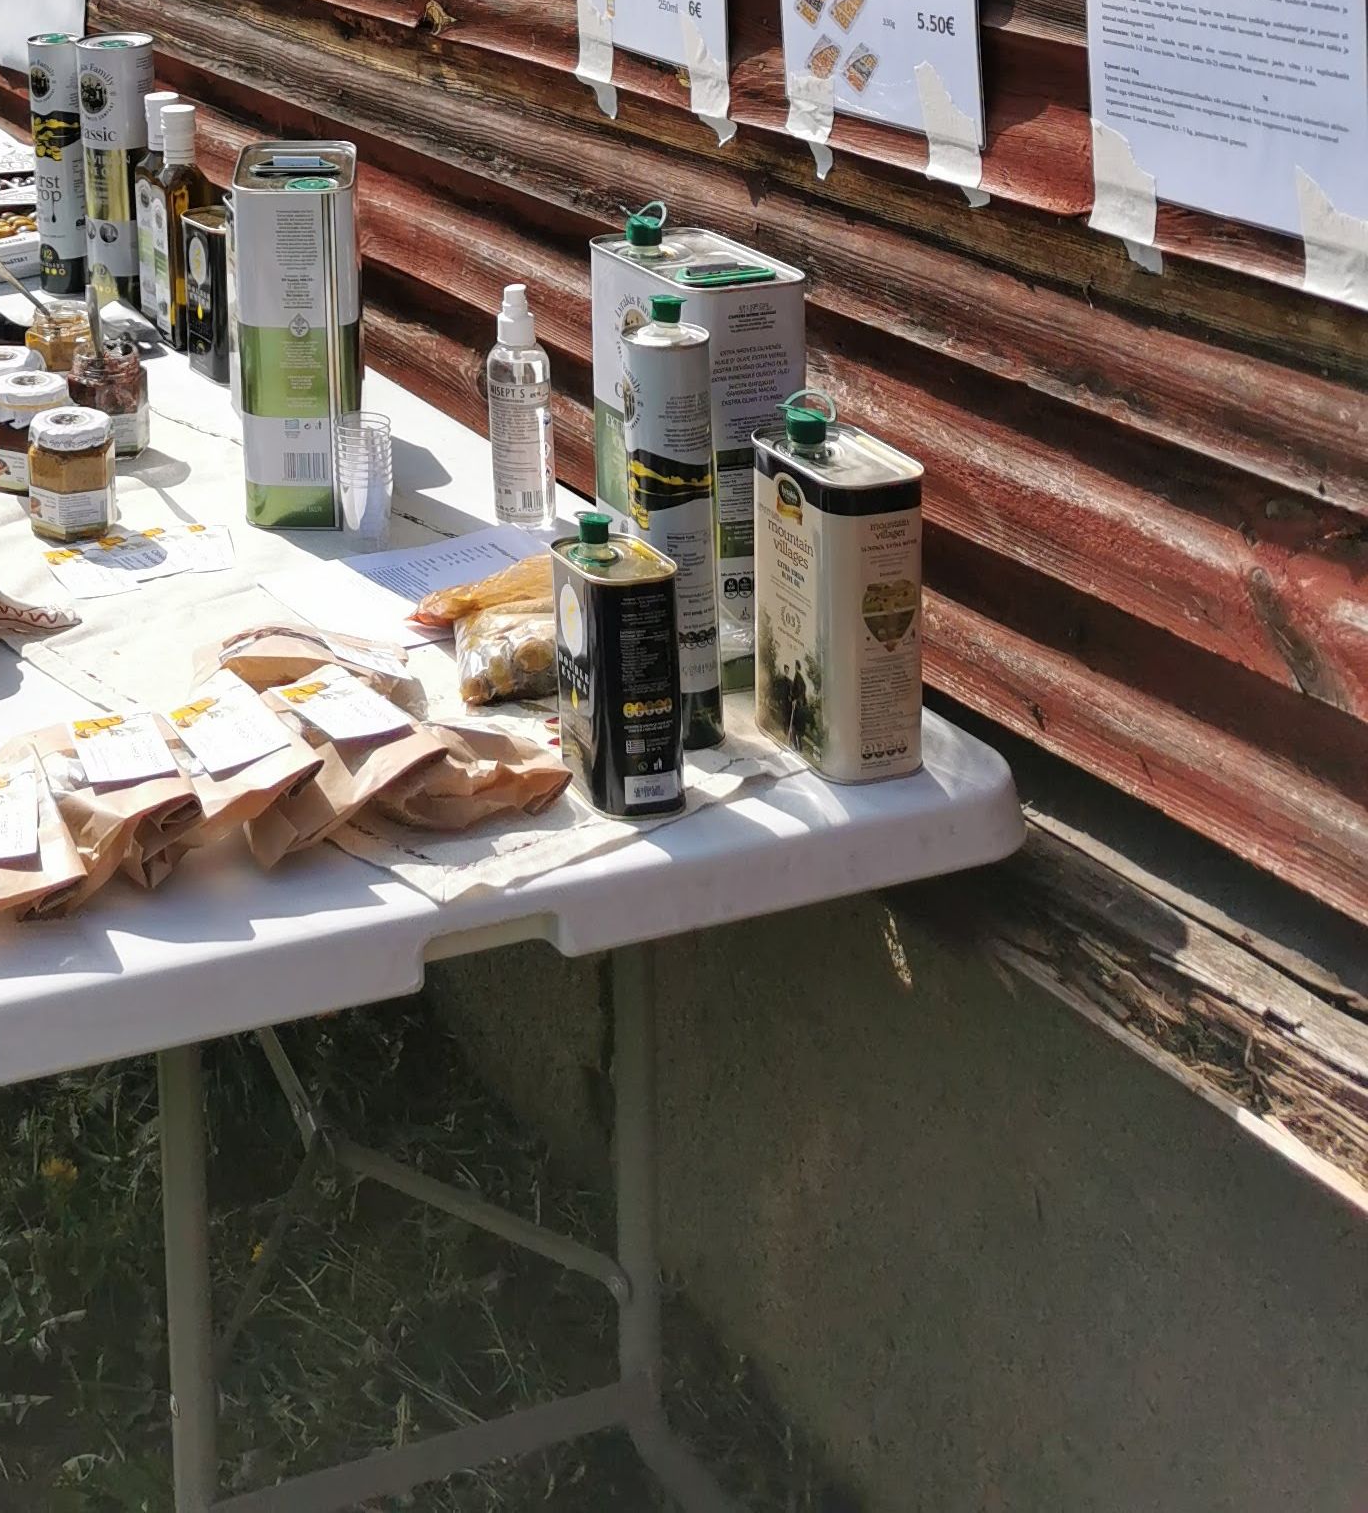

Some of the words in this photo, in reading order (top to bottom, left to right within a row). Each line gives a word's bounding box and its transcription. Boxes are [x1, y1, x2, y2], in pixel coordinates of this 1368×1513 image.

[688, 0, 702, 19] 6€
[917, 11, 956, 37] 5.50€
[84, 127, 117, 142] assic
[767, 518, 814, 557] mountain
[869, 518, 910, 532] mountain
[873, 529, 906, 541] villages
[773, 537, 809, 570] villages
[558, 650, 589, 685] DOUBLE
[561, 664, 587, 695] EXTRA
